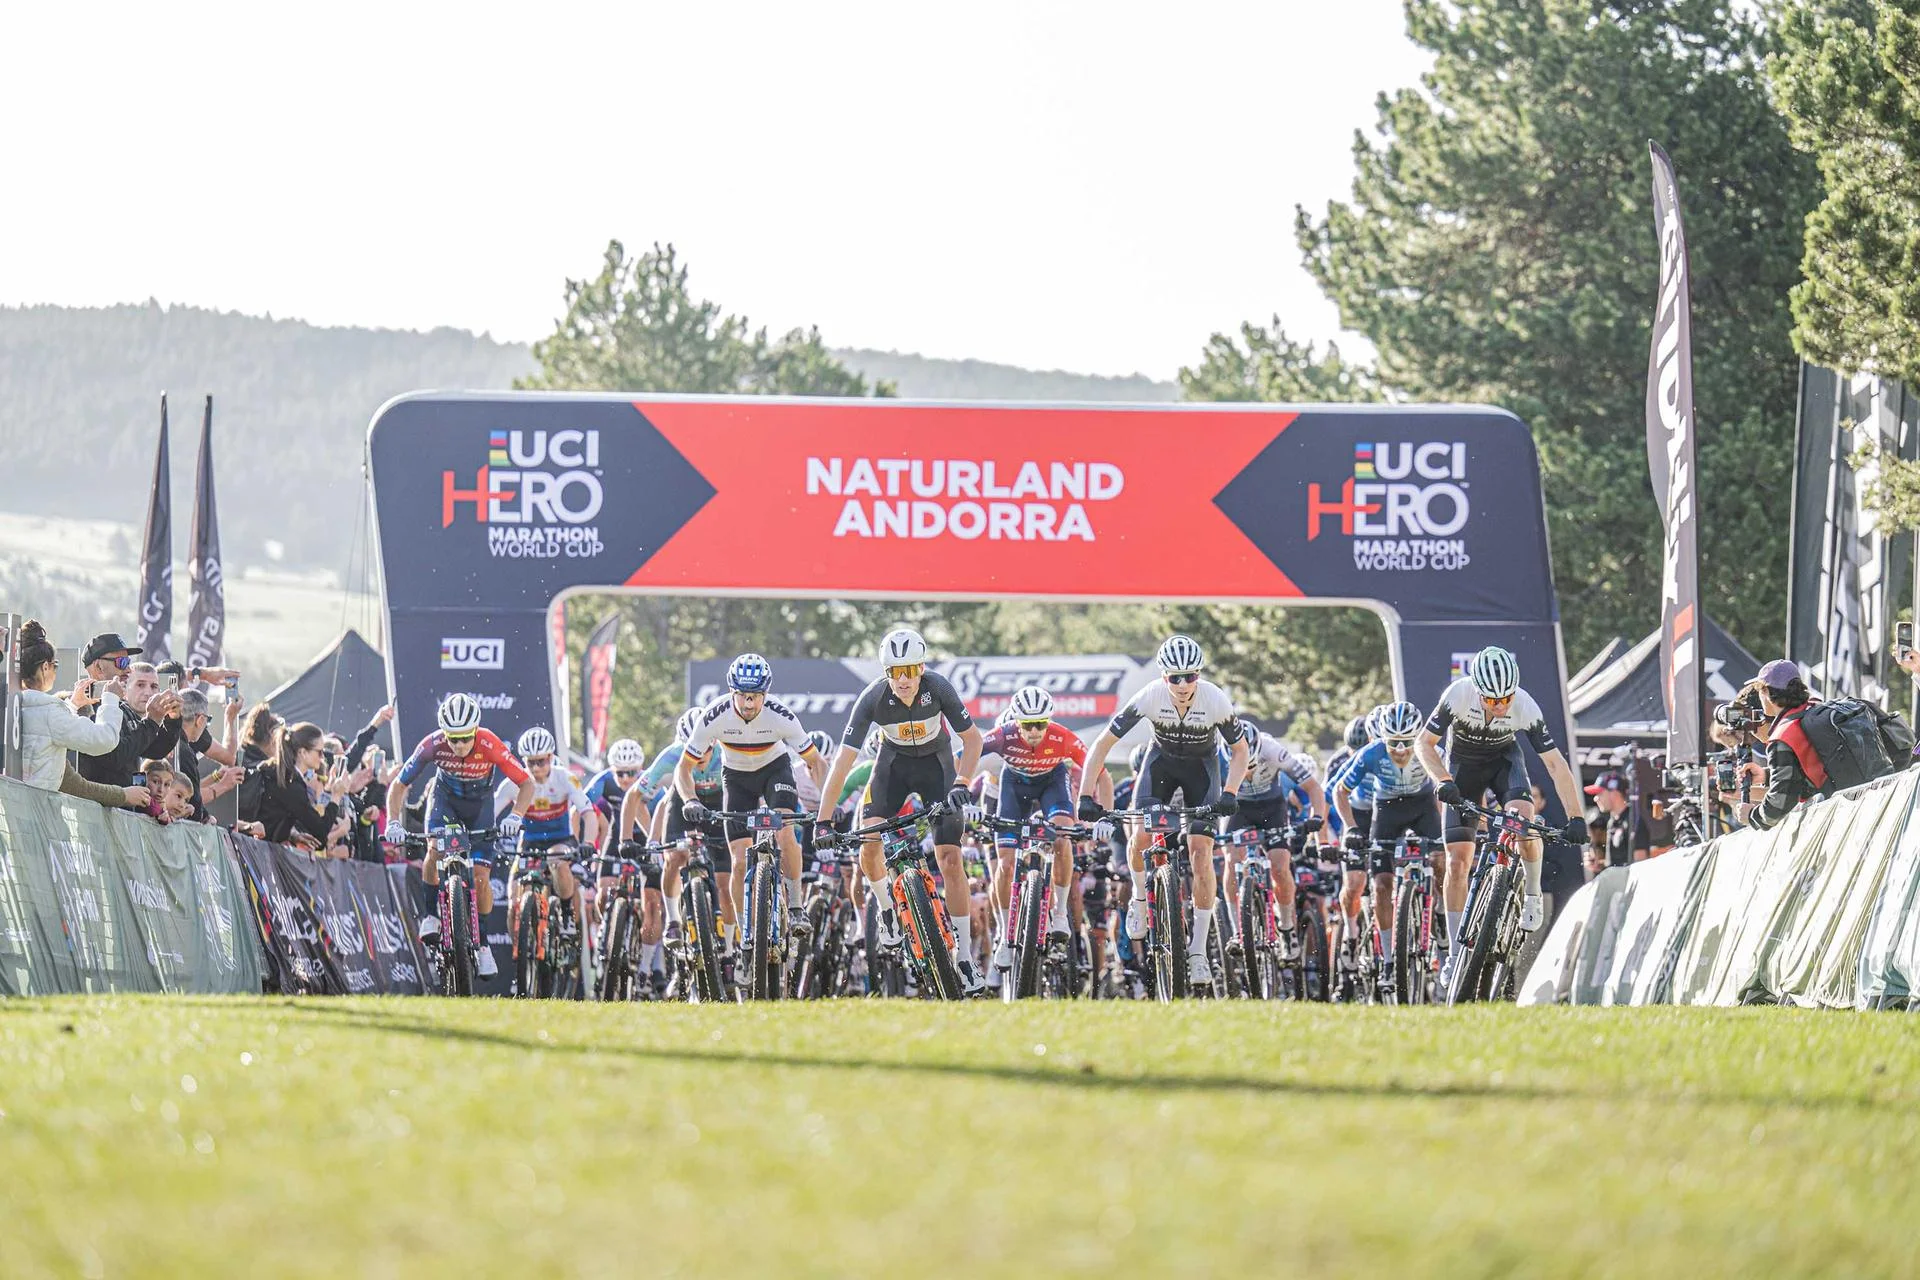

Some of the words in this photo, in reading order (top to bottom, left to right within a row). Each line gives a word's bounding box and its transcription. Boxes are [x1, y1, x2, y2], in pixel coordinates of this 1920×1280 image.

[510, 430, 600, 467] UCI
[1374, 442, 1466, 479] UCI
[806, 457, 1124, 500] NATURLAND
[442, 464, 603, 529] HERO
[1307, 476, 1470, 542] HERO
[833, 499, 1095, 541] ANDORRA
[488, 526, 599, 543] MARATHON
[489, 540, 560, 558] WORLD
[565, 541, 604, 558] CUP
[1353, 540, 1465, 555] MARATHON
[1354, 554, 1426, 571] WORLD
[1430, 554, 1470, 571] CUP
[453, 645, 498, 662] UCI
[980, 672, 1122, 694] SCOTT
[703, 700, 731, 727] KTM
[764, 700, 795, 722] KTM
[763, 816, 771, 826] 5
[1506, 818, 1522, 829] 32
[1036, 827, 1045, 837] 2
[1242, 829, 1258, 840] 13
[451, 837, 460, 847] 6
[1405, 846, 1421, 856] 12
